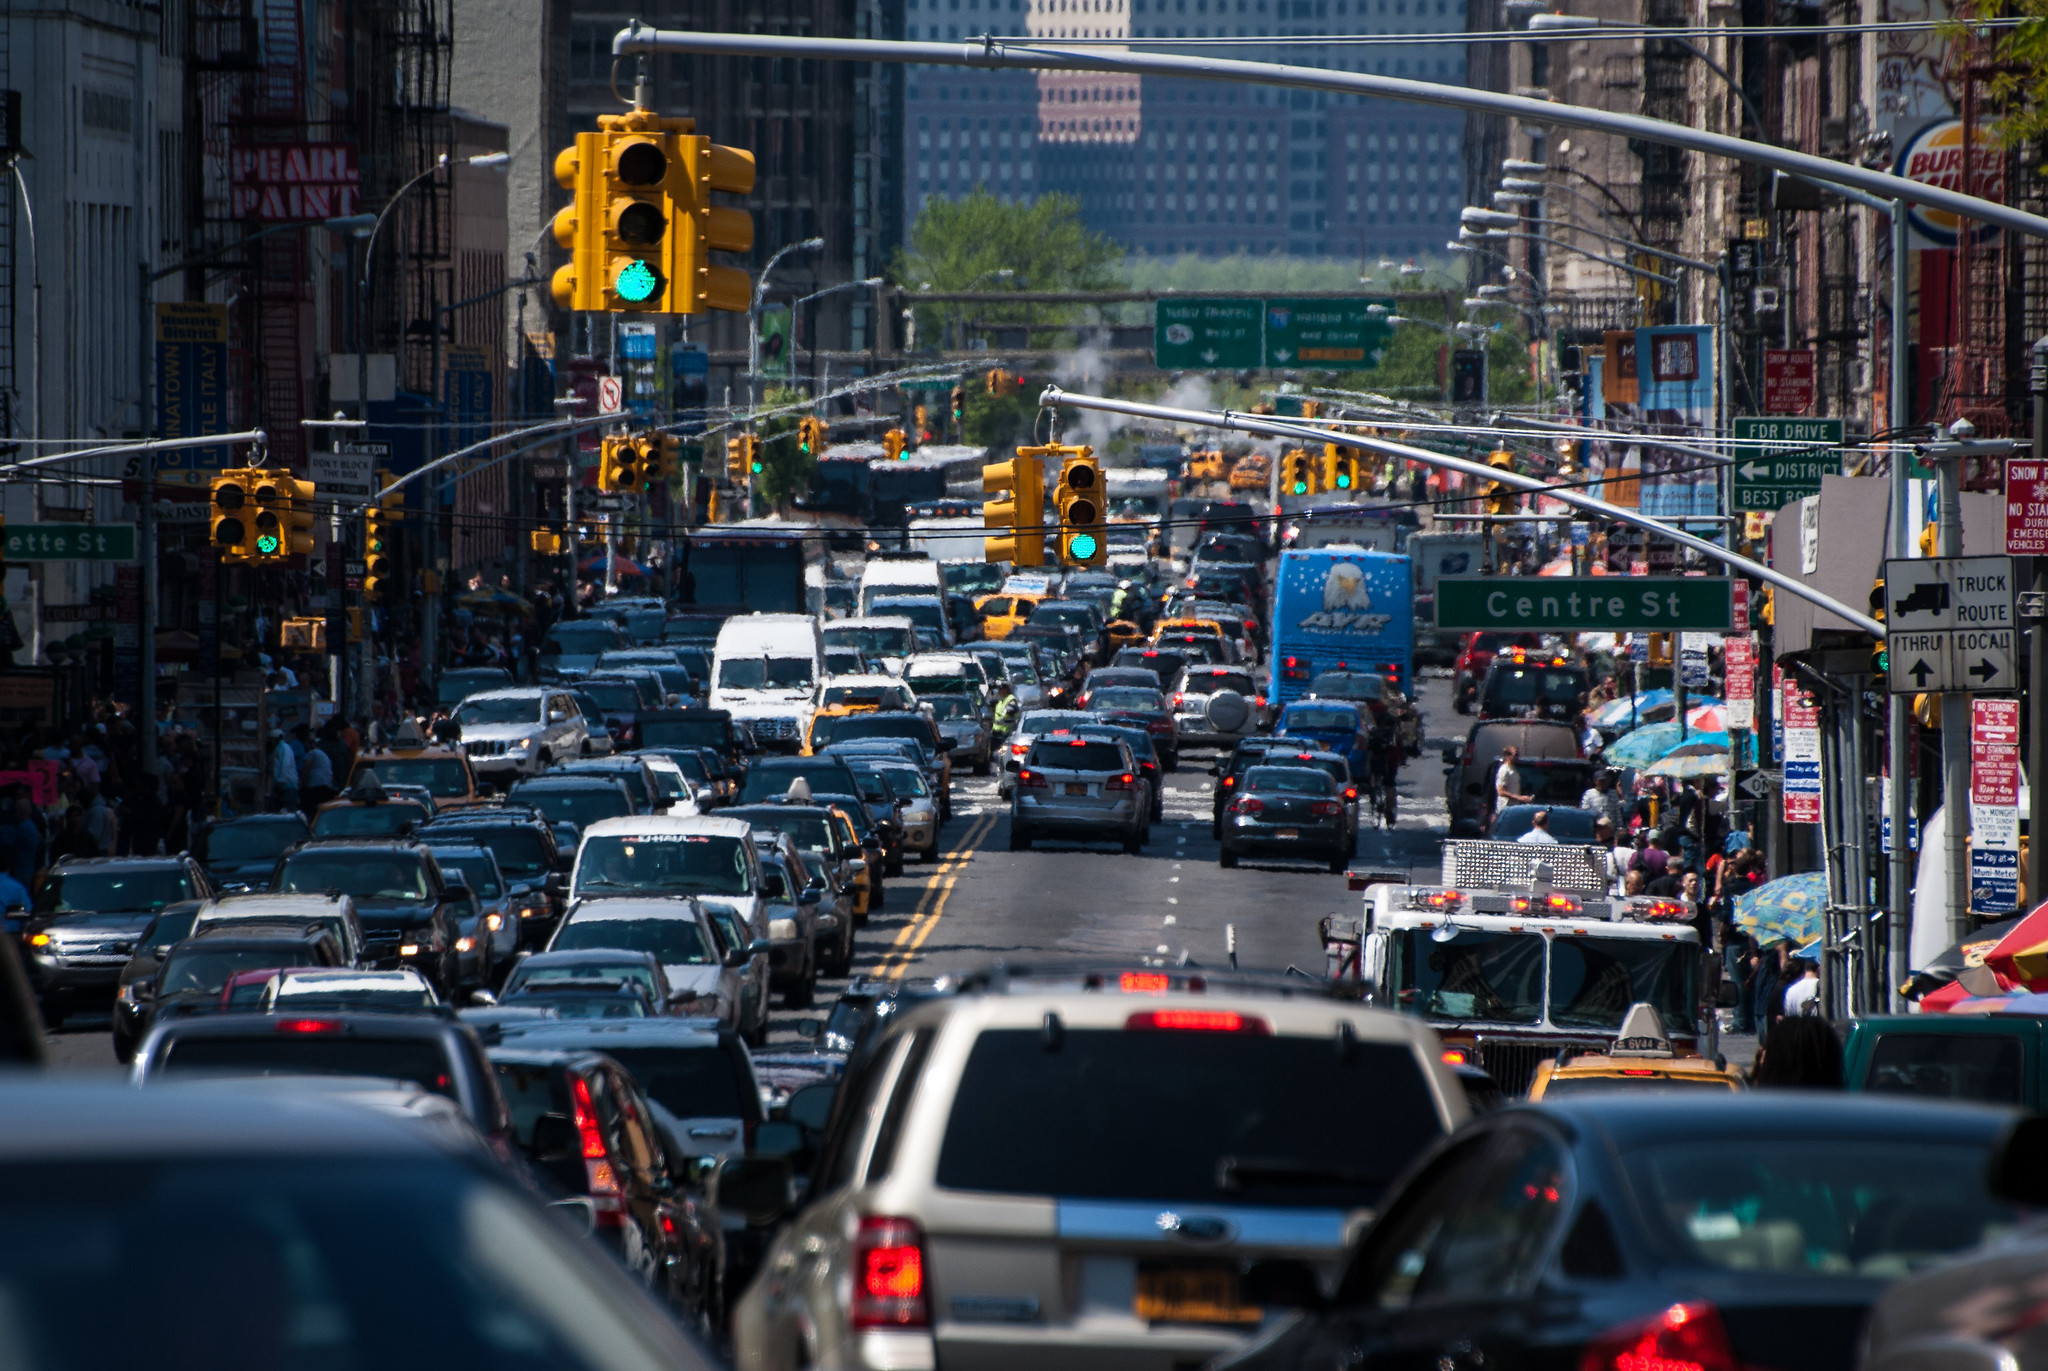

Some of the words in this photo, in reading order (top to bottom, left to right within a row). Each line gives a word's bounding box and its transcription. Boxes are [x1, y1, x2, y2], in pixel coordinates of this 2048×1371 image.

[232, 147, 359, 182] PEARL
[233, 185, 360, 218] PAINT
[163, 327, 217, 339] District
[1768, 353, 1788, 364] SNOW
[1791, 353, 1812, 364] ROUTE
[201, 345, 217, 397] ITALY
[1767, 378, 1778, 387] NO
[1780, 378, 1812, 388] STANDING
[164, 345, 181, 466] CINATOWN
[201, 401, 217, 465] LITLE
[1749, 423, 1779, 440] FDR
[1784, 424, 1829, 441] DRIVE
[341, 460, 369, 470] BLOCK
[1775, 463, 1840, 480] DISTRICT
[323, 470, 339, 478] THE
[341, 470, 358, 479] BOX
[2012, 467, 2038, 480] SNOW
[1742, 490, 1779, 506] BEST
[2009, 503, 2023, 516] NO
[9, 533, 66, 552] ette
[78, 532, 106, 553] St
[2008, 540, 2045, 550] VEHICLES
[1957, 576, 2006, 593] TRUCK
[1487, 591, 1625, 618] Centre
[1641, 591, 1681, 618] St
[1958, 605, 2008, 622] ROUTE
[1901, 635, 1940, 651] THRU
[1959, 634, 2009, 650] LOCAL
[1977, 703, 1987, 711] NO
[1988, 703, 2015, 713] STANDING
[1976, 746, 1986, 754] NO
[1987, 746, 2016, 755] STANDING
[639, 835, 689, 844] U-HAUL
[1984, 852, 1998, 865] Pay
[1998, 854, 2008, 863] at
[1973, 868, 2017, 878] Muni-Meter
[1629, 1038, 1653, 1049] 6V44
